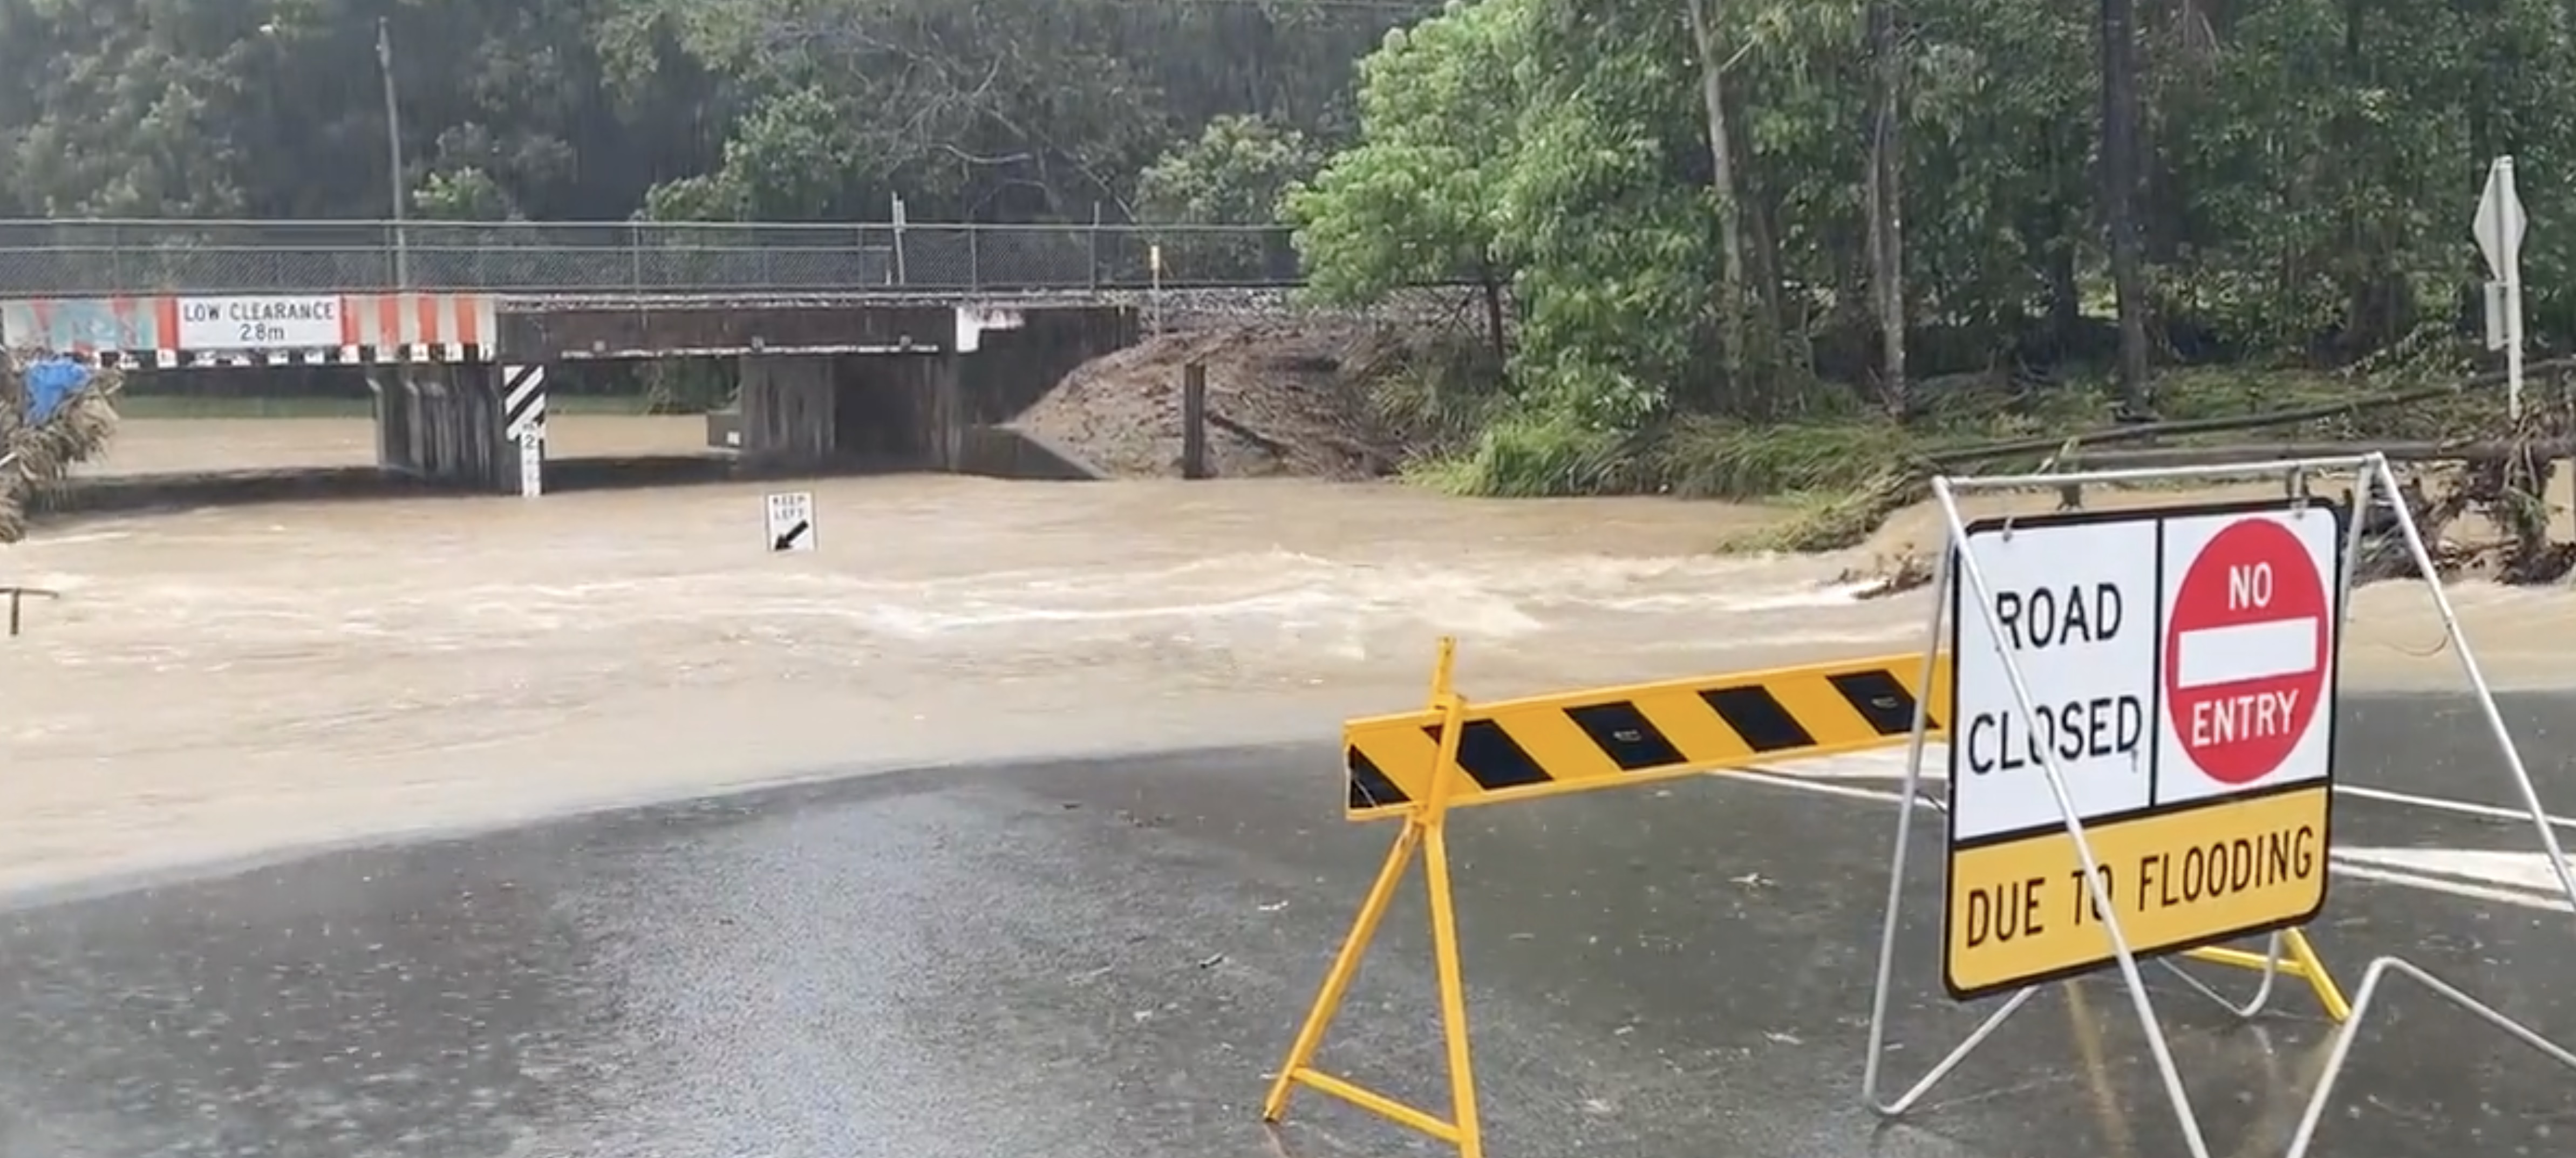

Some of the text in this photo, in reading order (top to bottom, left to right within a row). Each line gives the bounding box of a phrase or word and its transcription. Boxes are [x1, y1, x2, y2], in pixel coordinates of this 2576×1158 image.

[184, 301, 334, 322] LOW CLEARANCE
[1996, 582, 2122, 652] ROAD
[2229, 562, 2273, 610] NO
[1968, 694, 2142, 775] CLOSED
[2192, 689, 2300, 747] ENTRY
[1966, 826, 2314, 949] DUE TO FLOODING
